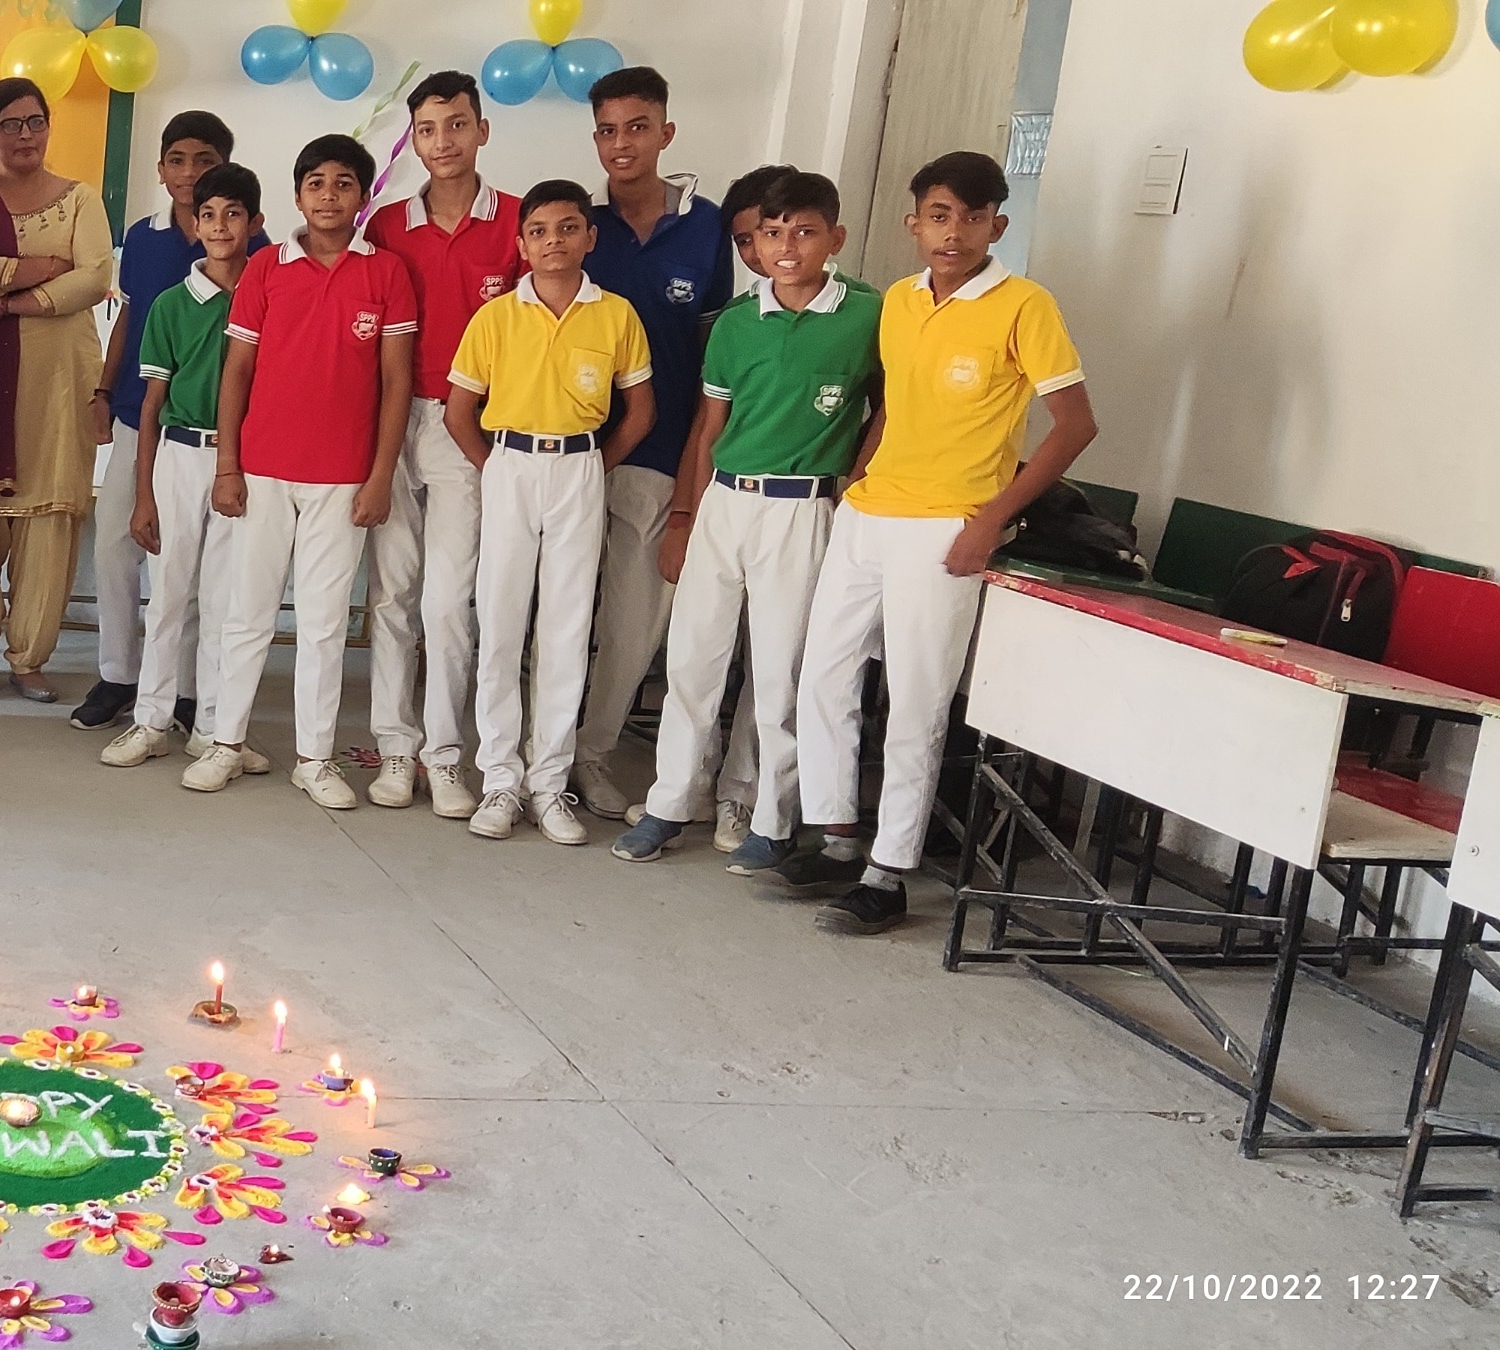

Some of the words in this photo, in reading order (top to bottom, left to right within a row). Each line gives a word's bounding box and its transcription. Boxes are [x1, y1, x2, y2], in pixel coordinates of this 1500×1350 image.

[486, 277, 504, 286] SPPS
[673, 279, 692, 291] SPPS
[359, 313, 375, 323] SPPS
